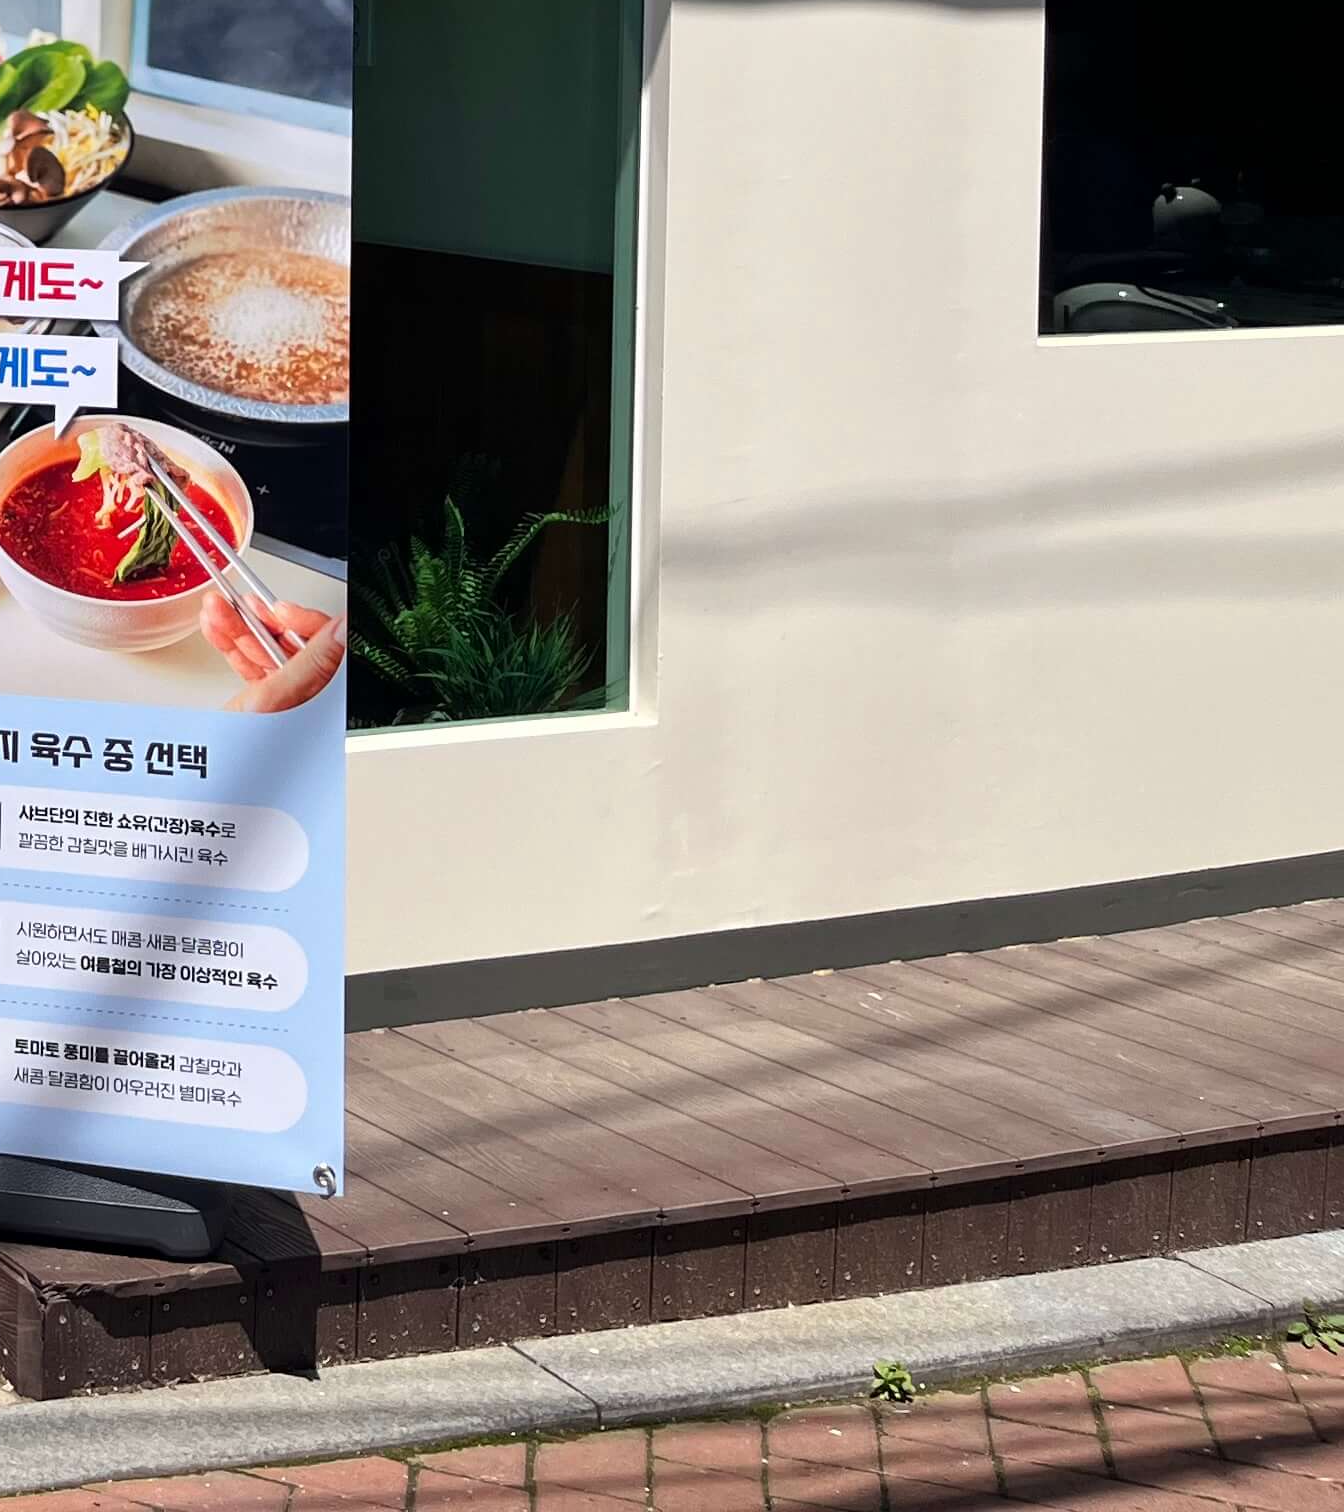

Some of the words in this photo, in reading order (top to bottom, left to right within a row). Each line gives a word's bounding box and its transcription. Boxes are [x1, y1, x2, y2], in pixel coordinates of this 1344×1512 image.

[30, 731, 93, 769] 육수
[103, 738, 134, 774] 중
[144, 740, 208, 779] 선택
[19, 804, 79, 824] 샤브단의
[83, 810, 113, 828] 진한
[116, 814, 236, 839] 쇼유(간장)육수로
[18, 832, 63, 851] 깔끔한
[68, 837, 128, 858] 감칠맛을
[132, 843, 194, 864] 배가시킨
[197, 848, 228, 867] 육수
[16, 921, 108, 945] 시원하면서도
[15, 948, 76, 970] 살아있는
[80, 955, 141, 977] 여름철의
[145, 961, 176, 980] 가장
[180, 965, 243, 987] 이상적인
[246, 972, 278, 990] 육수
[14, 1038, 61, 1058] 토마토
[63, 1043, 109, 1064] 풍미를
[113, 1048, 175, 1071] 끌어올려
[179, 1056, 242, 1078] 감칠맛과
[113, 1077, 175, 1100] 어우러진
[179, 1085, 242, 1107] 별미육수
